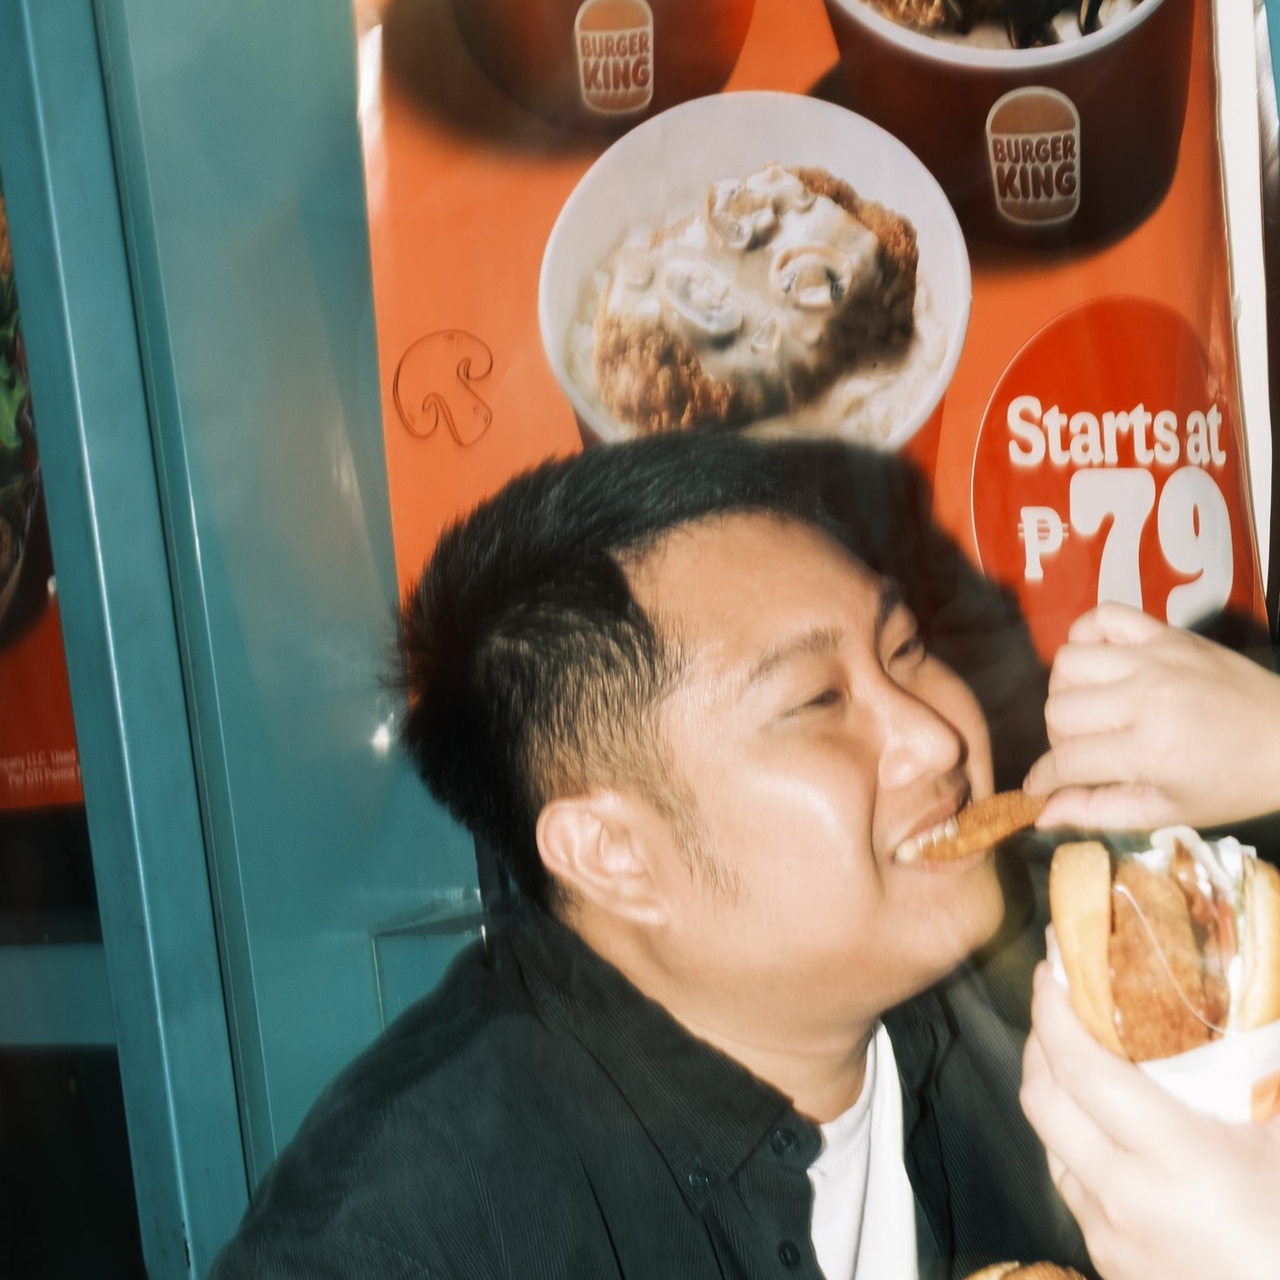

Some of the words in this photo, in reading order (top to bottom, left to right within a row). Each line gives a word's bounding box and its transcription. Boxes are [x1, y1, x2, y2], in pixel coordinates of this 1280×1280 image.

[580, 30, 650, 58] BURGER
[583, 55, 650, 90] KING
[992, 133, 1076, 163] BURGER
[996, 160, 1076, 198] KING
[1007, 395, 1180, 466] Starts
[1186, 403, 1226, 465] at
